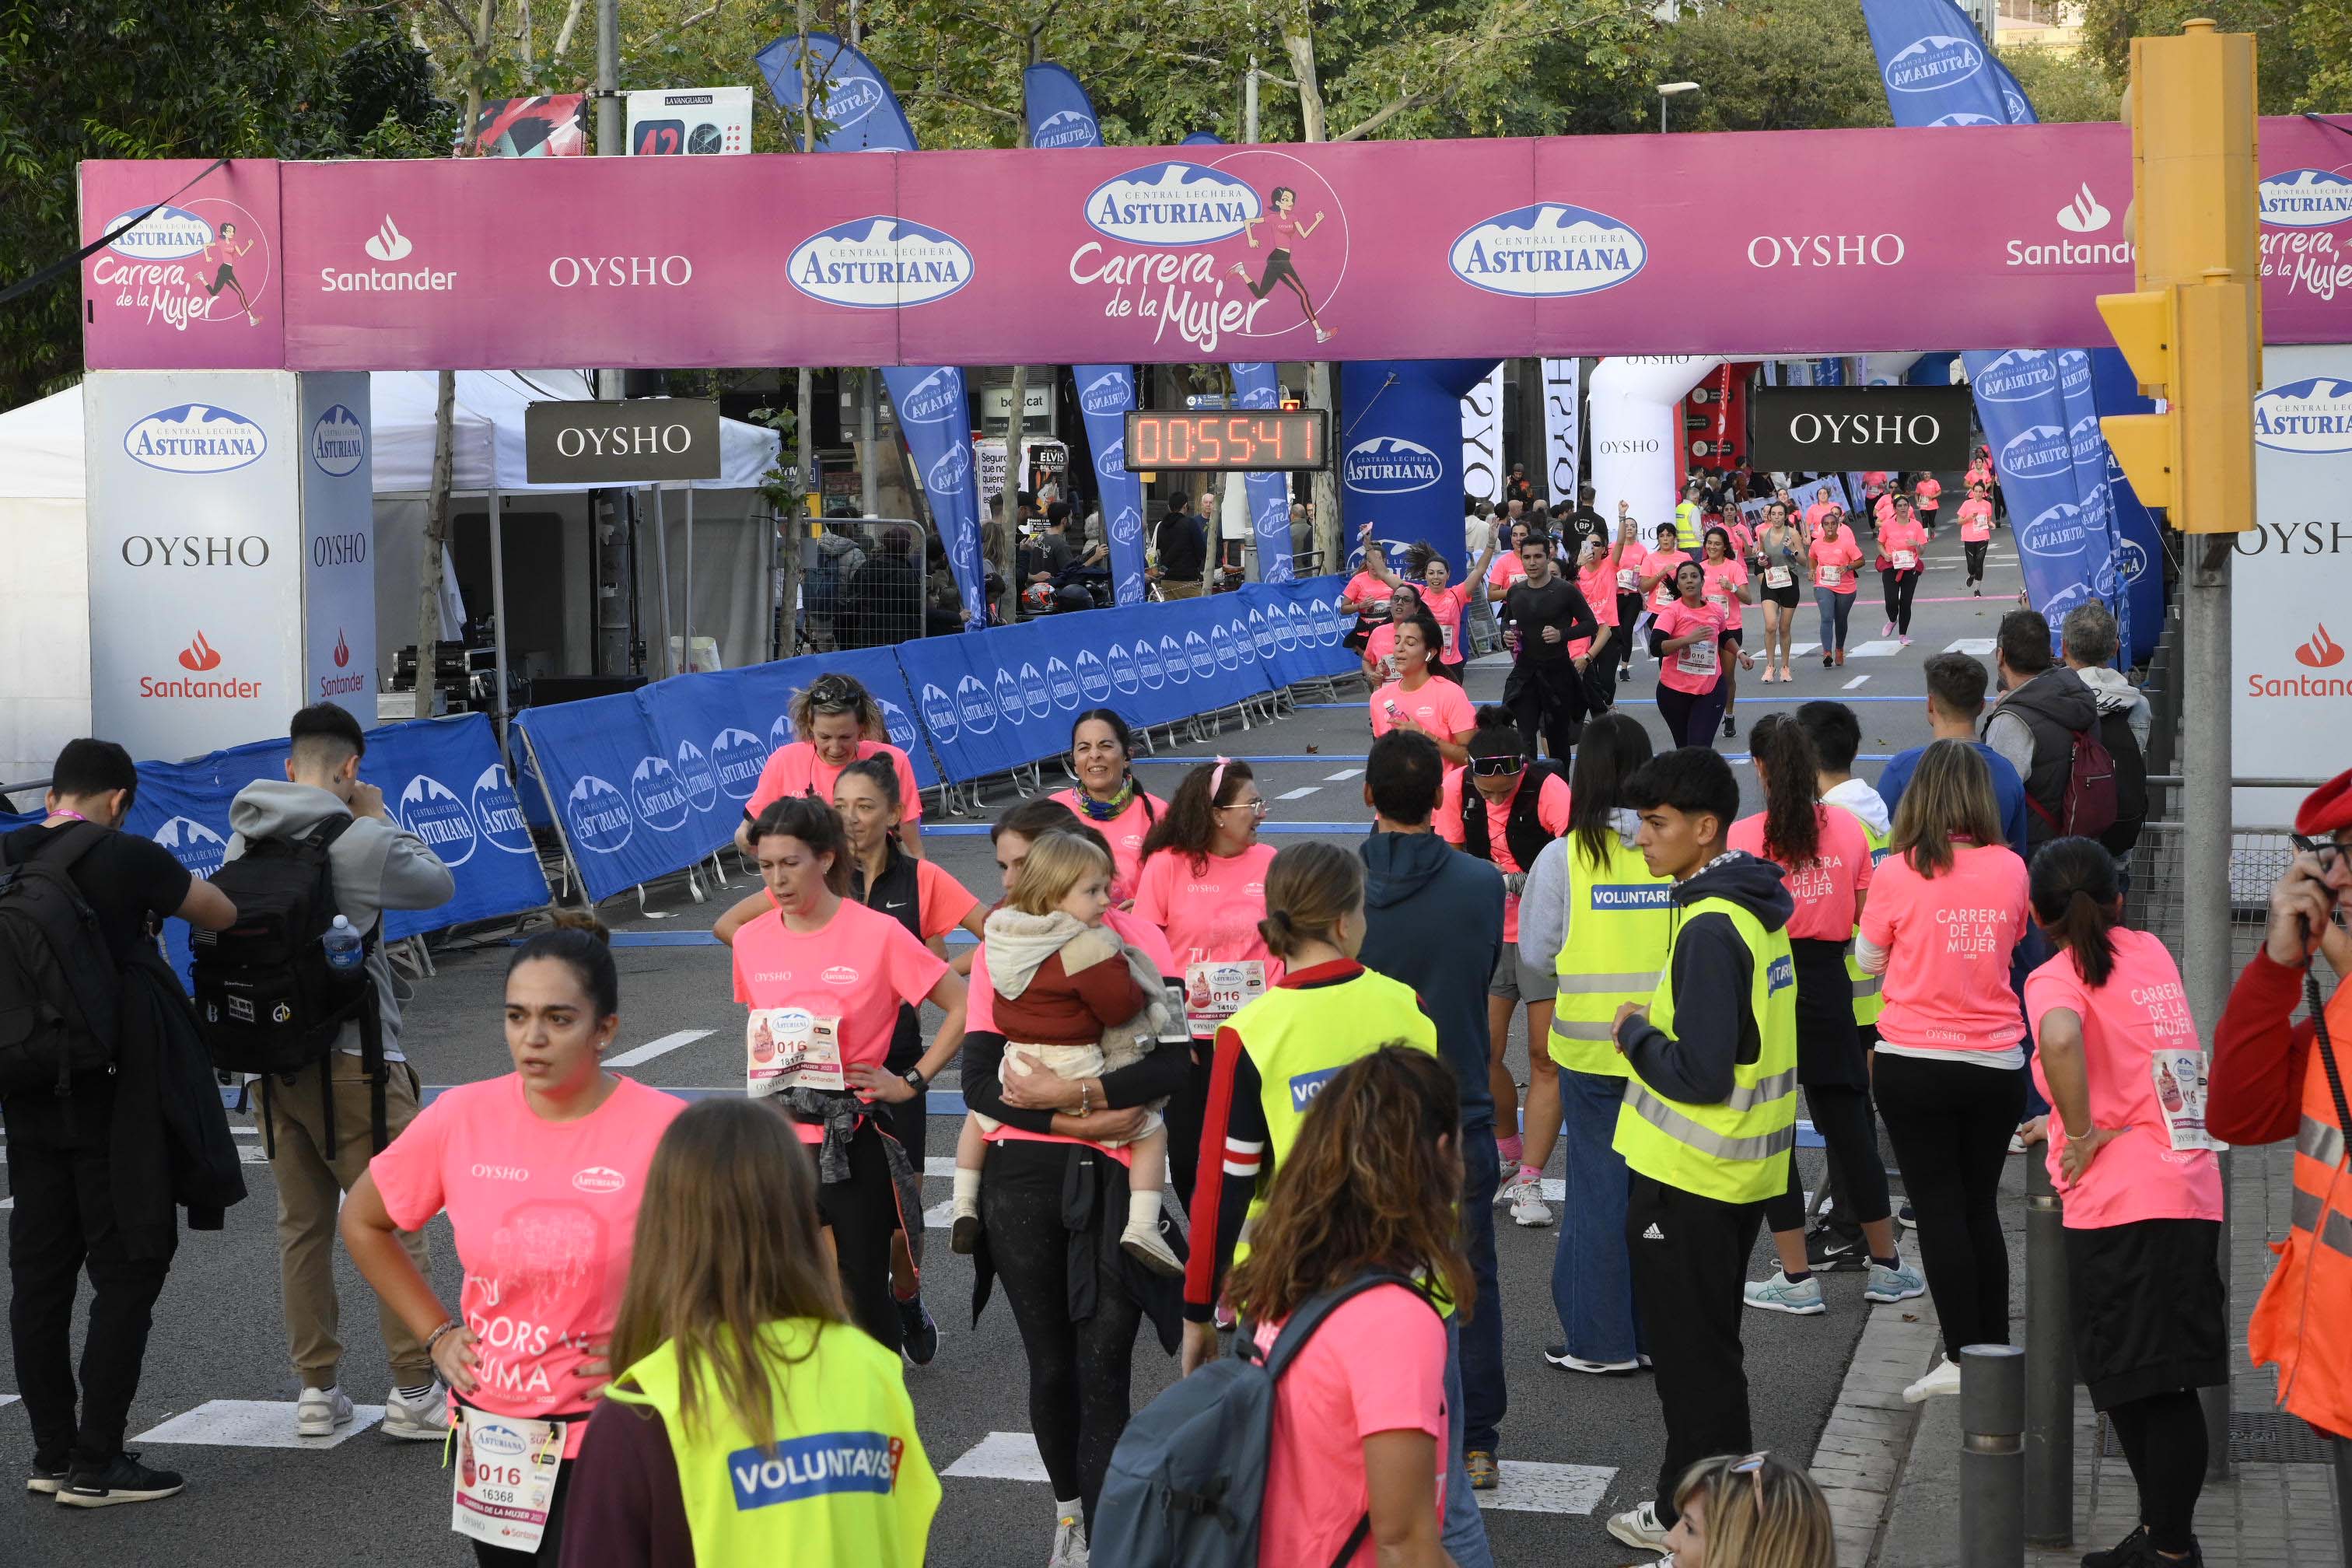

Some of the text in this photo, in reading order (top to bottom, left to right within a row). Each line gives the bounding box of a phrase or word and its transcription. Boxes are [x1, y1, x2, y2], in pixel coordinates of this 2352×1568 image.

[1125, 188, 1243, 200] CENTRAL LECHERA
[2270, 187, 2310, 196] CENTRAL
[1097, 193, 1248, 226] ASTURIANA
[829, 247, 953, 257] CENTRAL LECHERA
[1495, 235, 1625, 247] CENTRAL LECHERA
[1747, 234, 1905, 268] OYSHO
[2259, 231, 2333, 253] arrera
[1069, 242, 1215, 285] Carrera
[1464, 239, 1632, 274] ASTURIANA
[2006, 240, 2136, 266] Santan
[93, 256, 186, 286] Carrera
[549, 255, 693, 287] OYSHO
[800, 250, 960, 285] ASTURIANA
[2277, 260, 2291, 277] la
[2287, 248, 2352, 301] Muje
[321, 267, 457, 292] Santander
[116, 286, 149, 308] de la
[147, 282, 220, 331] Mujer
[1105, 286, 1157, 318] de la
[1153, 279, 1269, 353] Mujer
[2276, 404, 2329, 412] CENTRAL
[156, 427, 253, 436] CENTRAL LECHERA
[1461, 376, 1495, 499] OYS
[1548, 358, 1573, 495] OYSH
[1790, 413, 1940, 446] OYSHO
[135, 429, 257, 457] ASTURIANA
[316, 431, 362, 460] ASTURIANA
[556, 424, 692, 457] OYSHO
[1137, 419, 1311, 463] 00:55:41
[1600, 439, 1659, 455] OYSHO
[1040, 452, 1064, 462] ELVIS
[982, 465, 996, 474] que
[1347, 460, 1435, 481] ASTURIANA
[314, 532, 366, 567] OYSHO
[2233, 521, 2352, 556] OYSH
[121, 535, 269, 567] OYSHO
[141, 676, 262, 698] Santander
[320, 671, 365, 698] Santander
[2249, 674, 2352, 698] Santan
[717, 754, 767, 784] ASTURIAN
[1188, 884, 1220, 894] OYSHO
[1793, 870, 1830, 887] DE LA
[1790, 883, 1833, 898] MUJER
[1936, 908, 2007, 923] CARRERA
[1949, 923, 1994, 938] DE LA
[1188, 947, 1212, 964] TU
[1947, 938, 1997, 954] MUJER
[754, 971, 792, 983] OYSHO
[1213, 990, 1240, 1003] 016
[2148, 1002, 2185, 1020] DE LA
[1926, 1029, 1966, 1042] OYSHO
[2153, 1017, 2193, 1038] MUJER
[778, 1041, 807, 1054] 016
[781, 1053, 805, 1066] 18172
[471, 1163, 530, 1182] OYSHO
[1643, 1231, 1664, 1240] adidas
[478, 1463, 522, 1486] 016
[481, 1488, 514, 1503] 16368
[485, 1505, 494, 1514] DE
[494, 1507, 504, 1516] LA
[504, 1509, 530, 1520] MUJER
